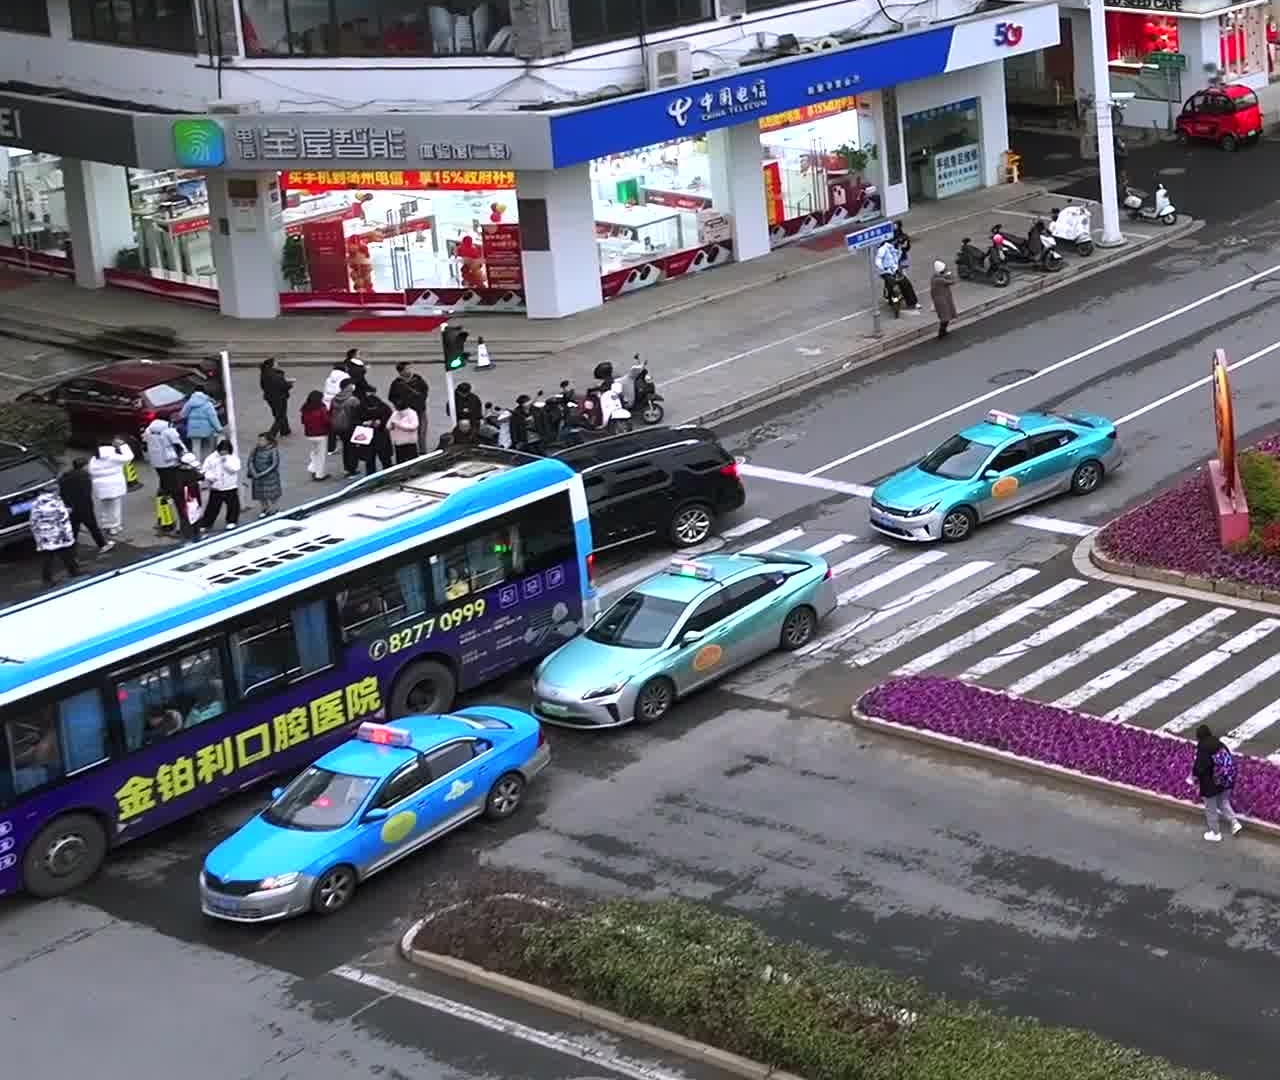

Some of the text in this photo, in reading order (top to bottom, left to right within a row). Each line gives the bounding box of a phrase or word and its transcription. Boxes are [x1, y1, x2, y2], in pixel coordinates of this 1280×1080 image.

[701, 79, 767, 113] 中国电信
[729, 98, 768, 117] TELECOM
[262, 127, 408, 160] 全屋智能
[389, 617, 435, 654] 8277
[440, 598, 486, 632] 0999
[114, 675, 383, 822] 金铂利口腔医院
